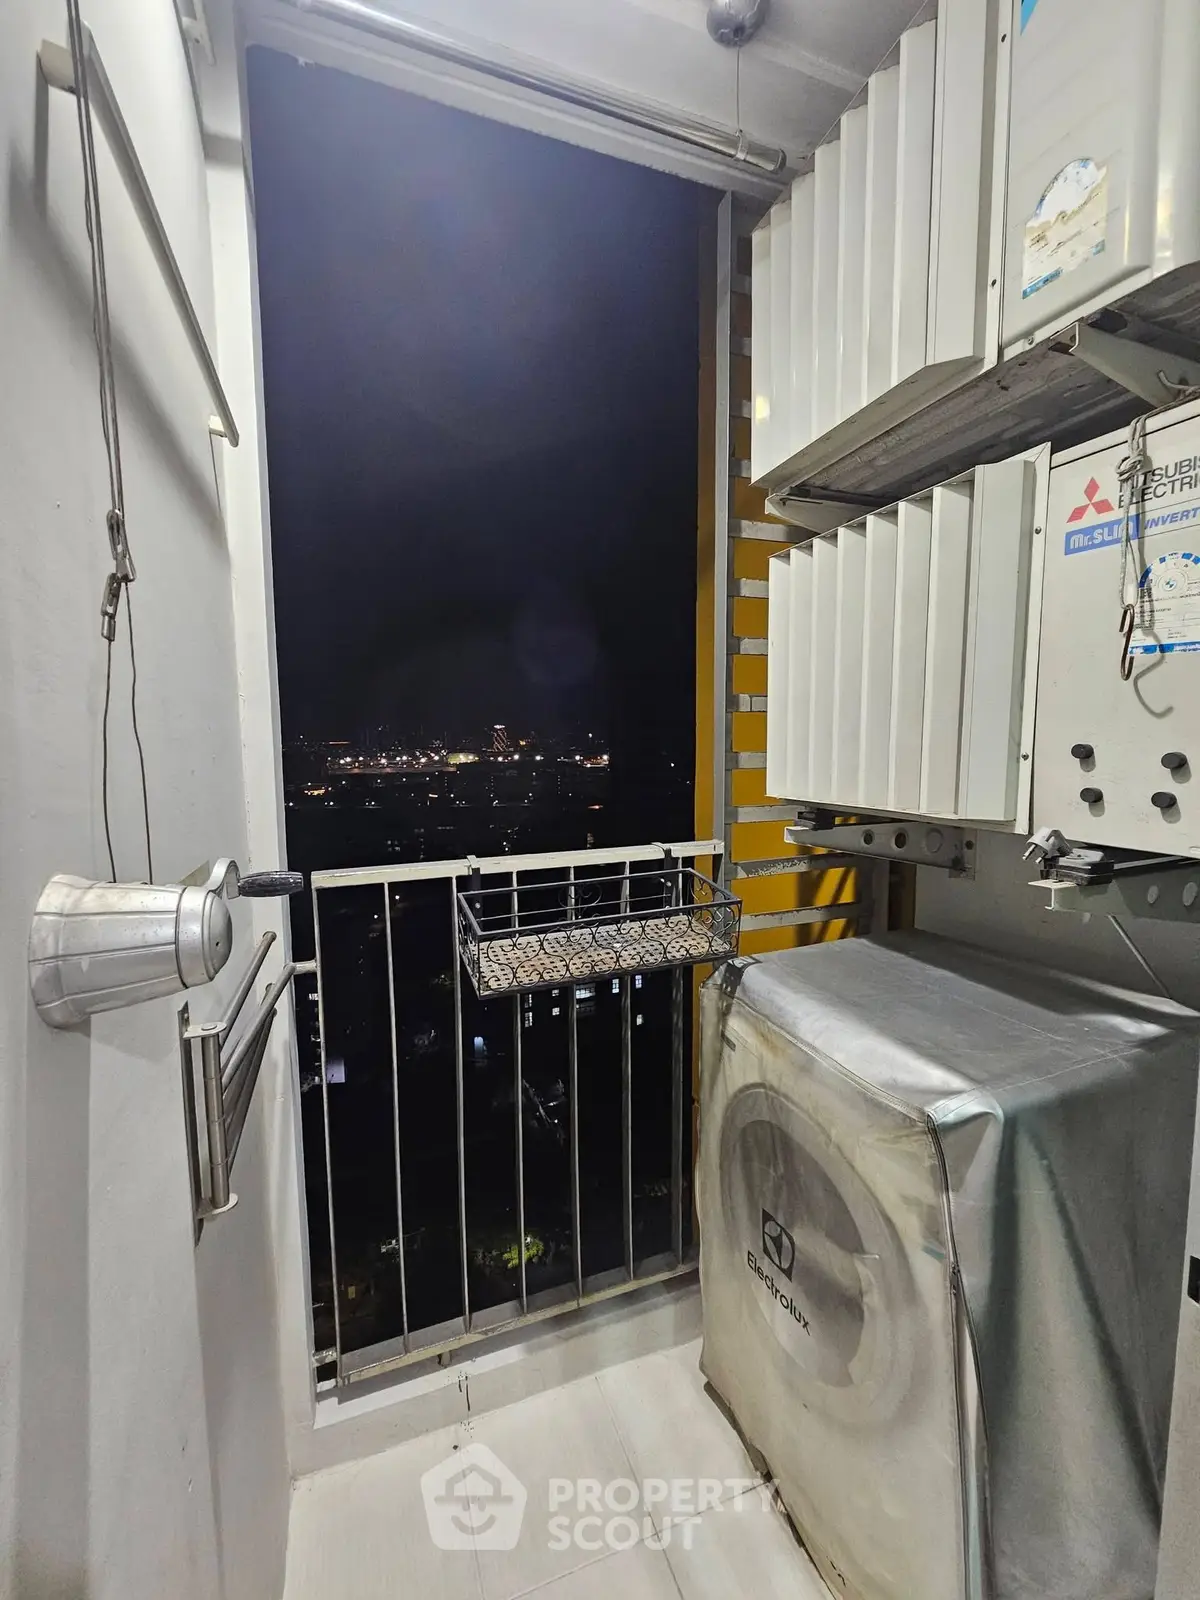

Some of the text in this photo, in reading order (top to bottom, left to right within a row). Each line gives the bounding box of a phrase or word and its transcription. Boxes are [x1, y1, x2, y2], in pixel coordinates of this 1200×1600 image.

[1118, 473, 1200, 509] ELECTRI
[1119, 455, 1200, 493] ITSUBI
[747, 1250, 811, 1336] Electrolux
